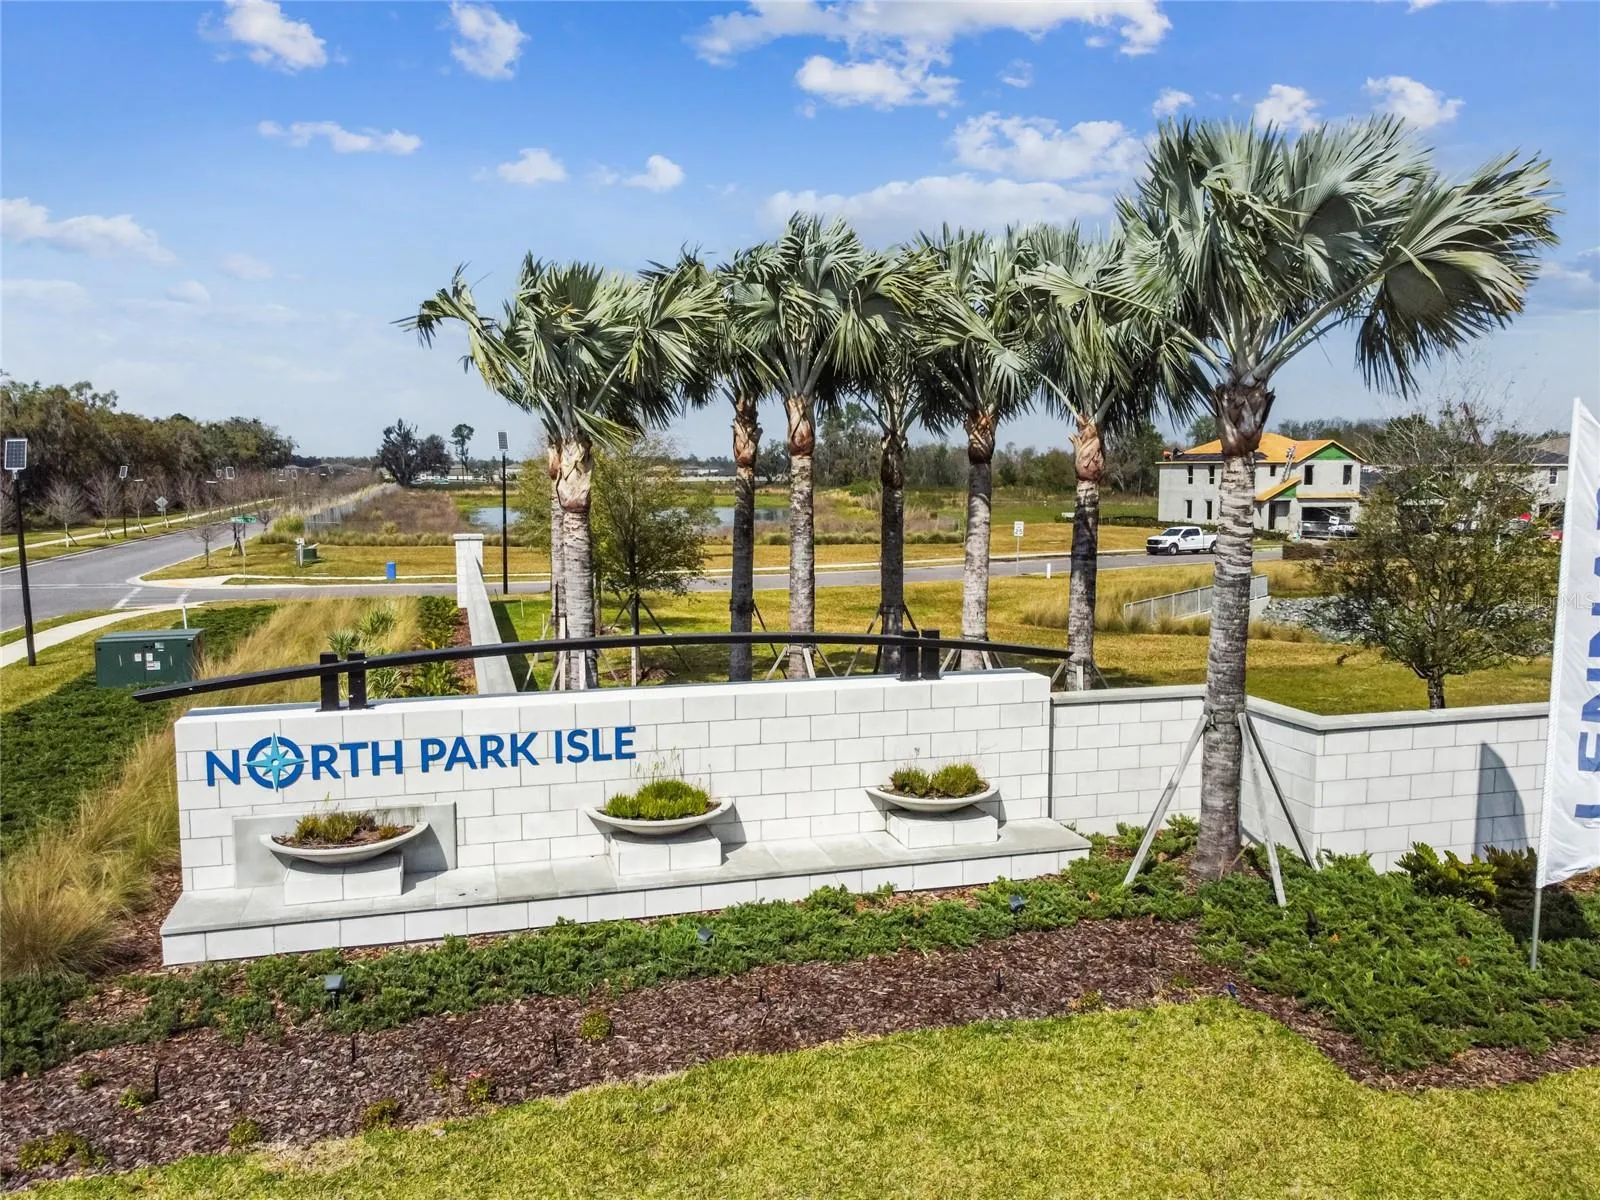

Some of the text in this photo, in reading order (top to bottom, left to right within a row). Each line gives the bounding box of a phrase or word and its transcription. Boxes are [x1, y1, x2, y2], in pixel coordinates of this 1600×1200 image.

[206, 726, 636, 791] NORTH PARK ISLE
